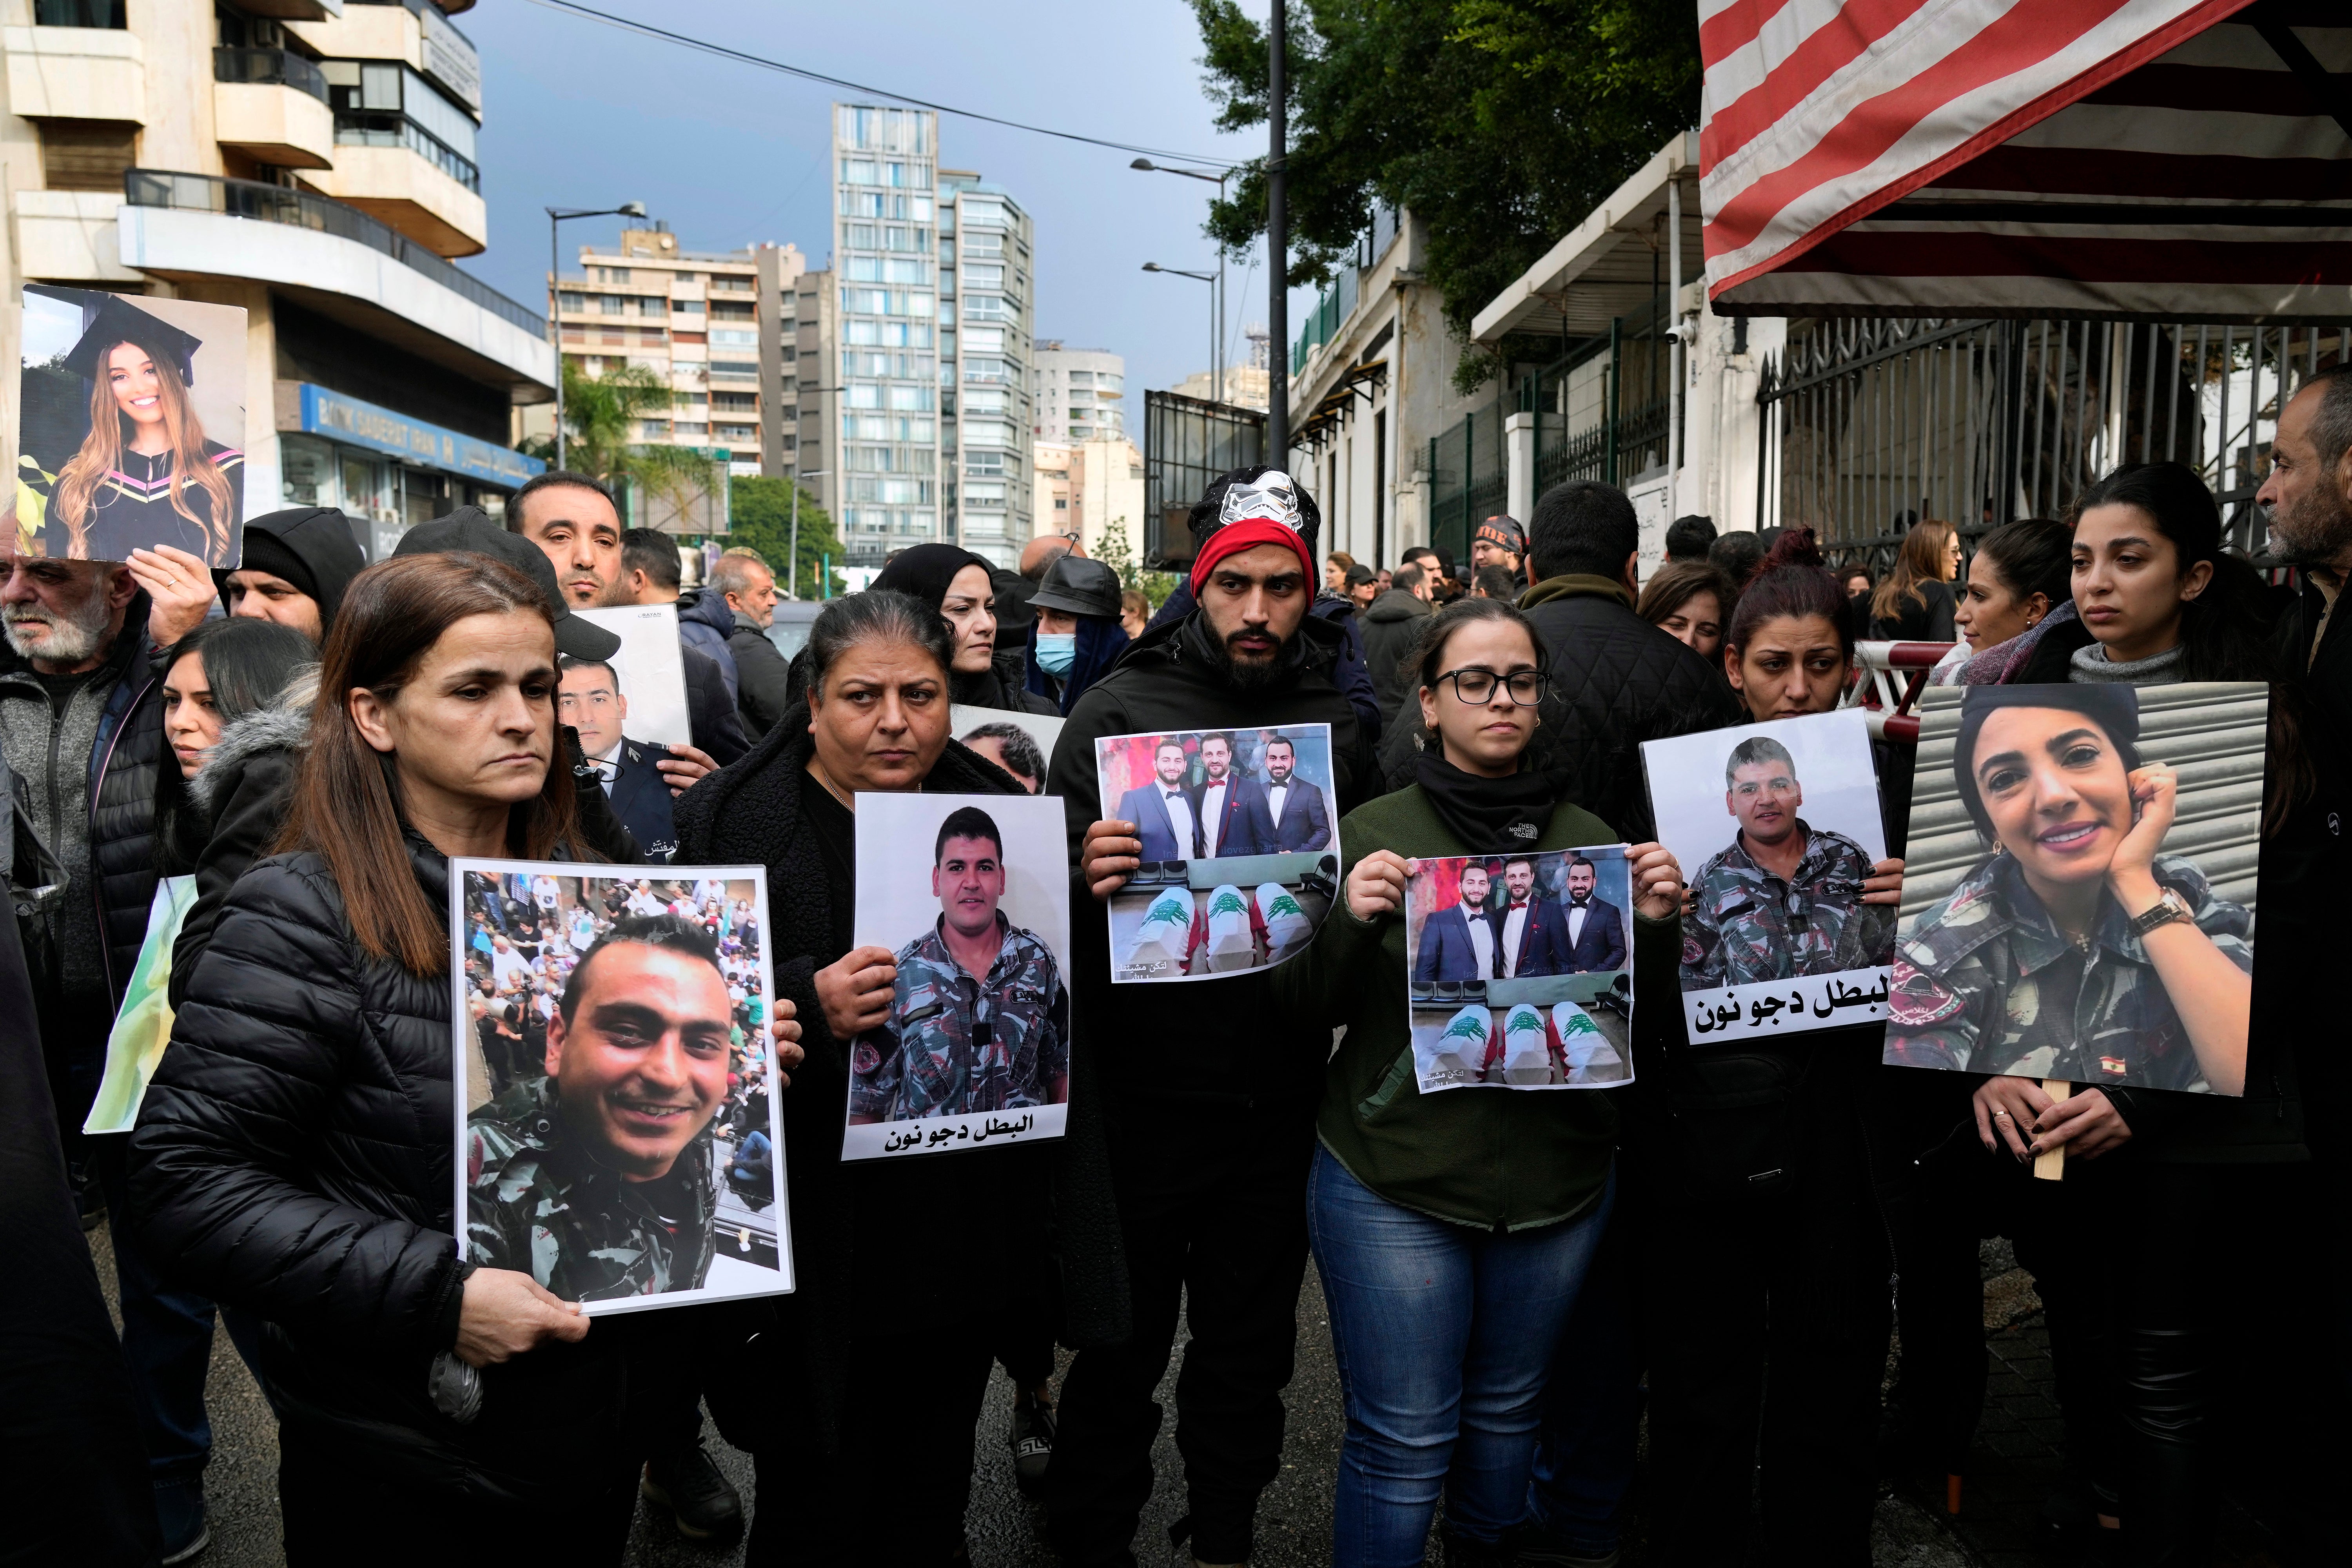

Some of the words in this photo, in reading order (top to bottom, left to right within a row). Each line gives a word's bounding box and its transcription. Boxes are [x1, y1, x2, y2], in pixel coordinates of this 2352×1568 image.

[1221, 844, 1283, 855] ilovezgharta
[1149, 961, 1167, 973] لتكن
[1813, 973, 1892, 1018] لبطل
[1695, 991, 1741, 1033] نون
[1448, 1070, 1464, 1079] لتكن
[884, 1124, 922, 1152] نون
[974, 1113, 1033, 1142] البطل
